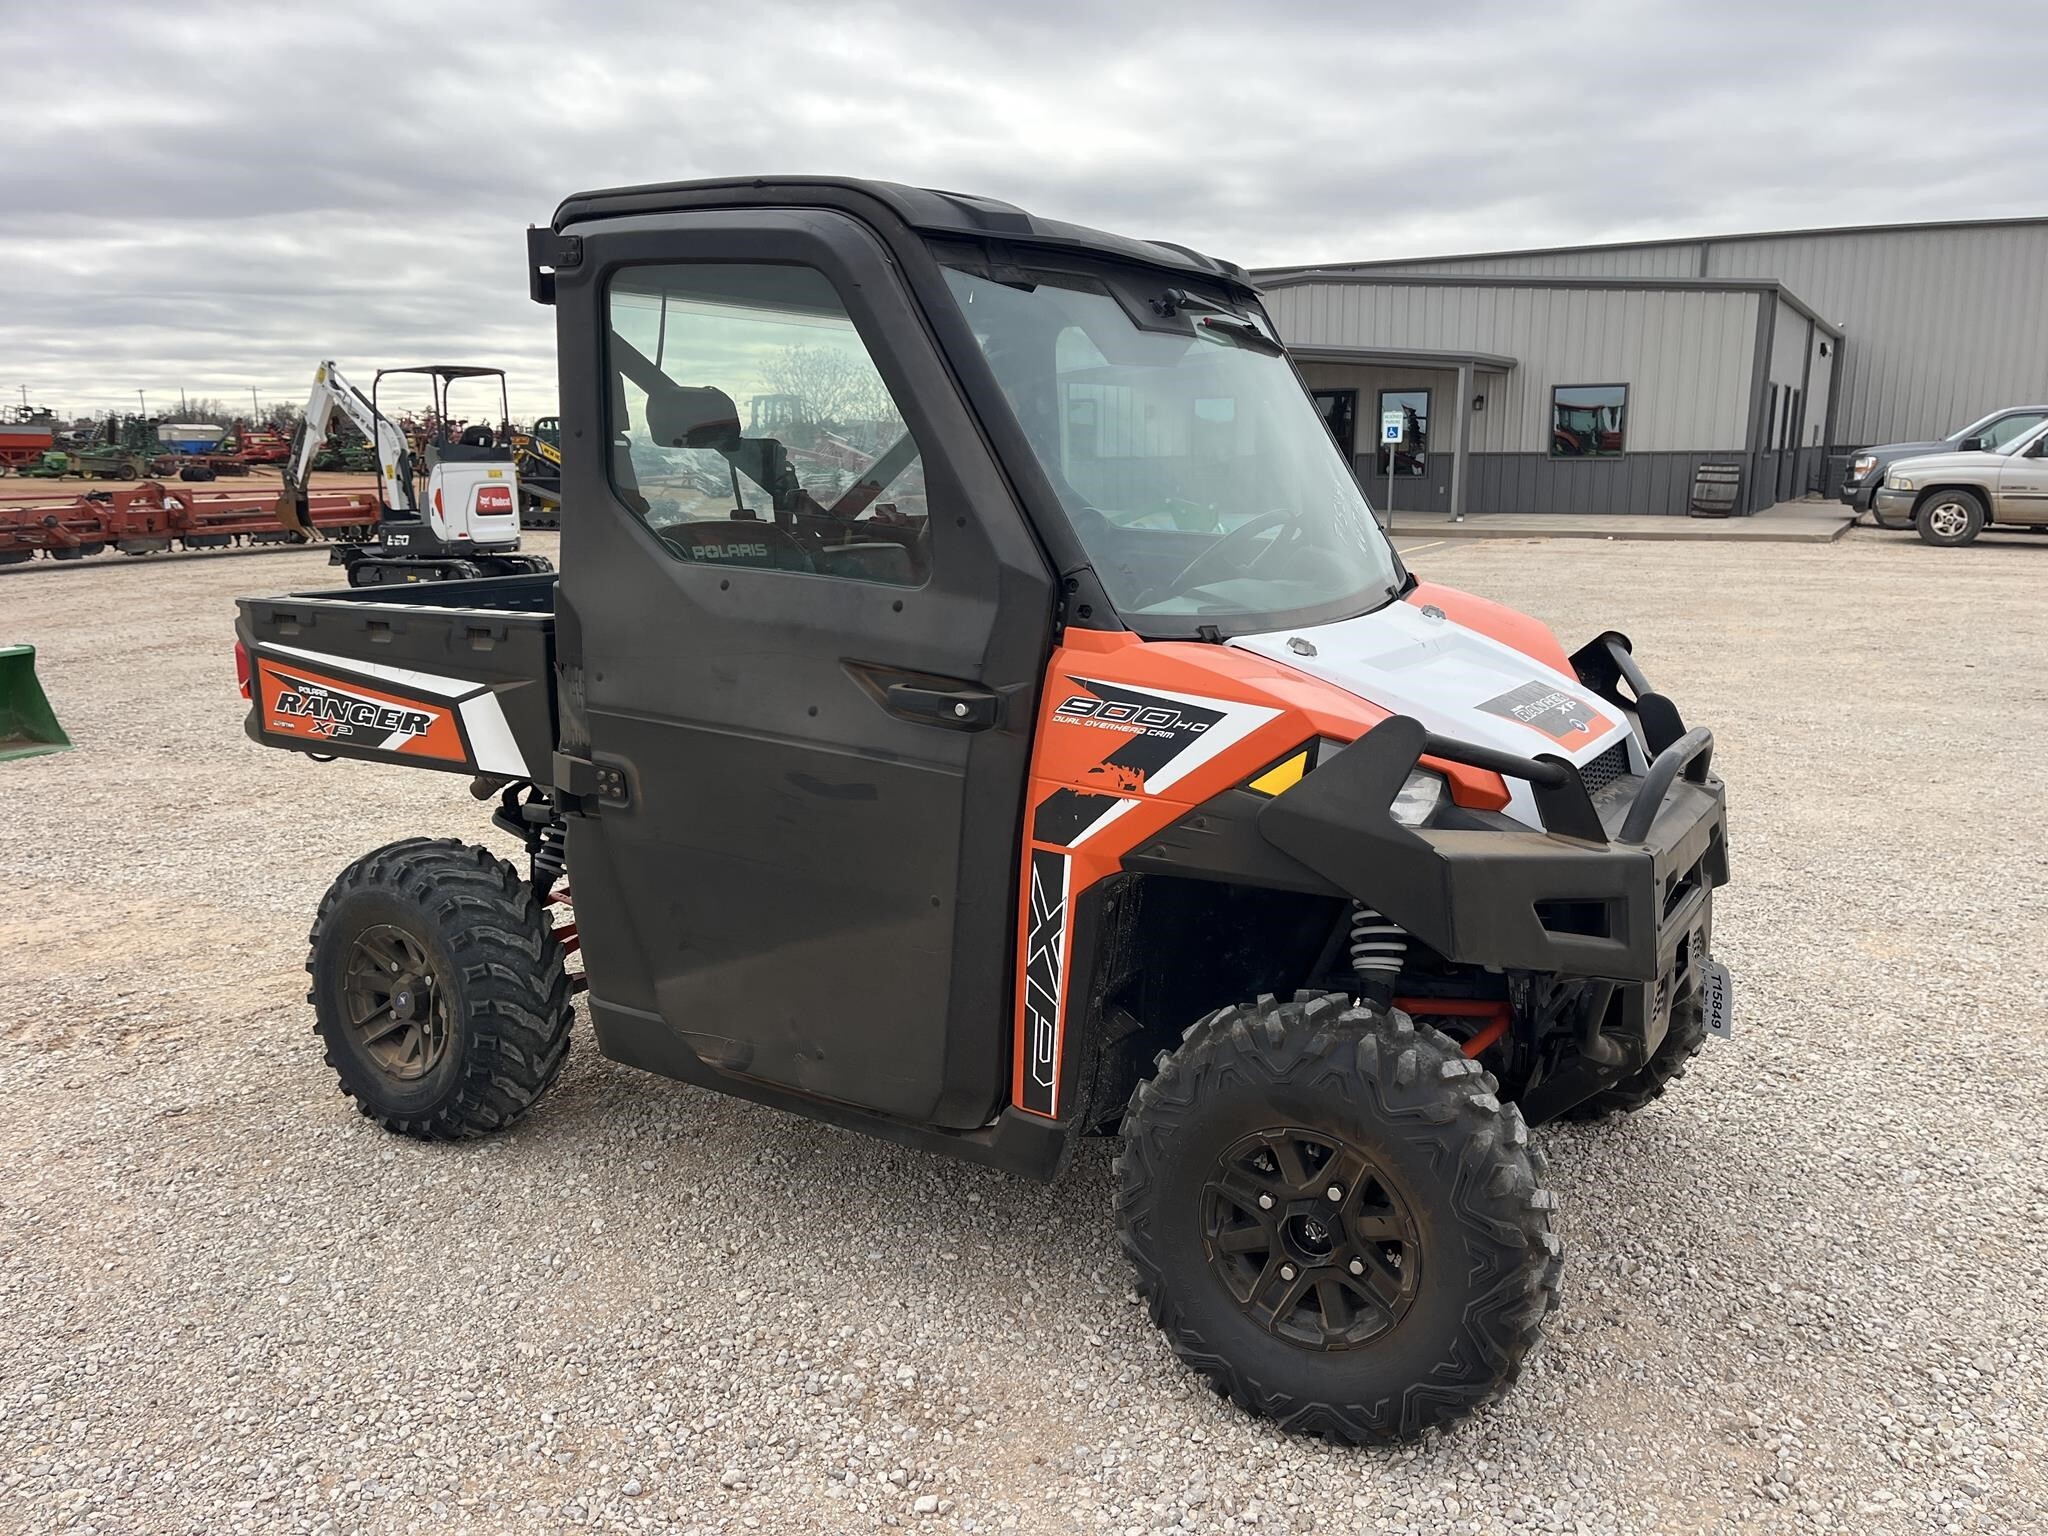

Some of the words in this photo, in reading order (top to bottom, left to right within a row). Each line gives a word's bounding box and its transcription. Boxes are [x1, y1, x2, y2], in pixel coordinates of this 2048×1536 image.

[491, 496, 511, 507] Bobcat
[691, 543, 768, 560] POLARIS
[298, 685, 329, 698] POLARIS
[274, 690, 431, 736] RANGER
[1054, 695, 1182, 729] 900
[1514, 692, 1570, 722] RANGER
[1555, 700, 1577, 715] XP
[308, 719, 354, 737] XP
[1052, 715, 1082, 726] DUAL
[1084, 719, 1147, 735] OVERHEAD
[1146, 728, 1175, 739] CAM
[1026, 859, 1068, 1088] XP
[1710, 974, 1723, 1029] T15849
